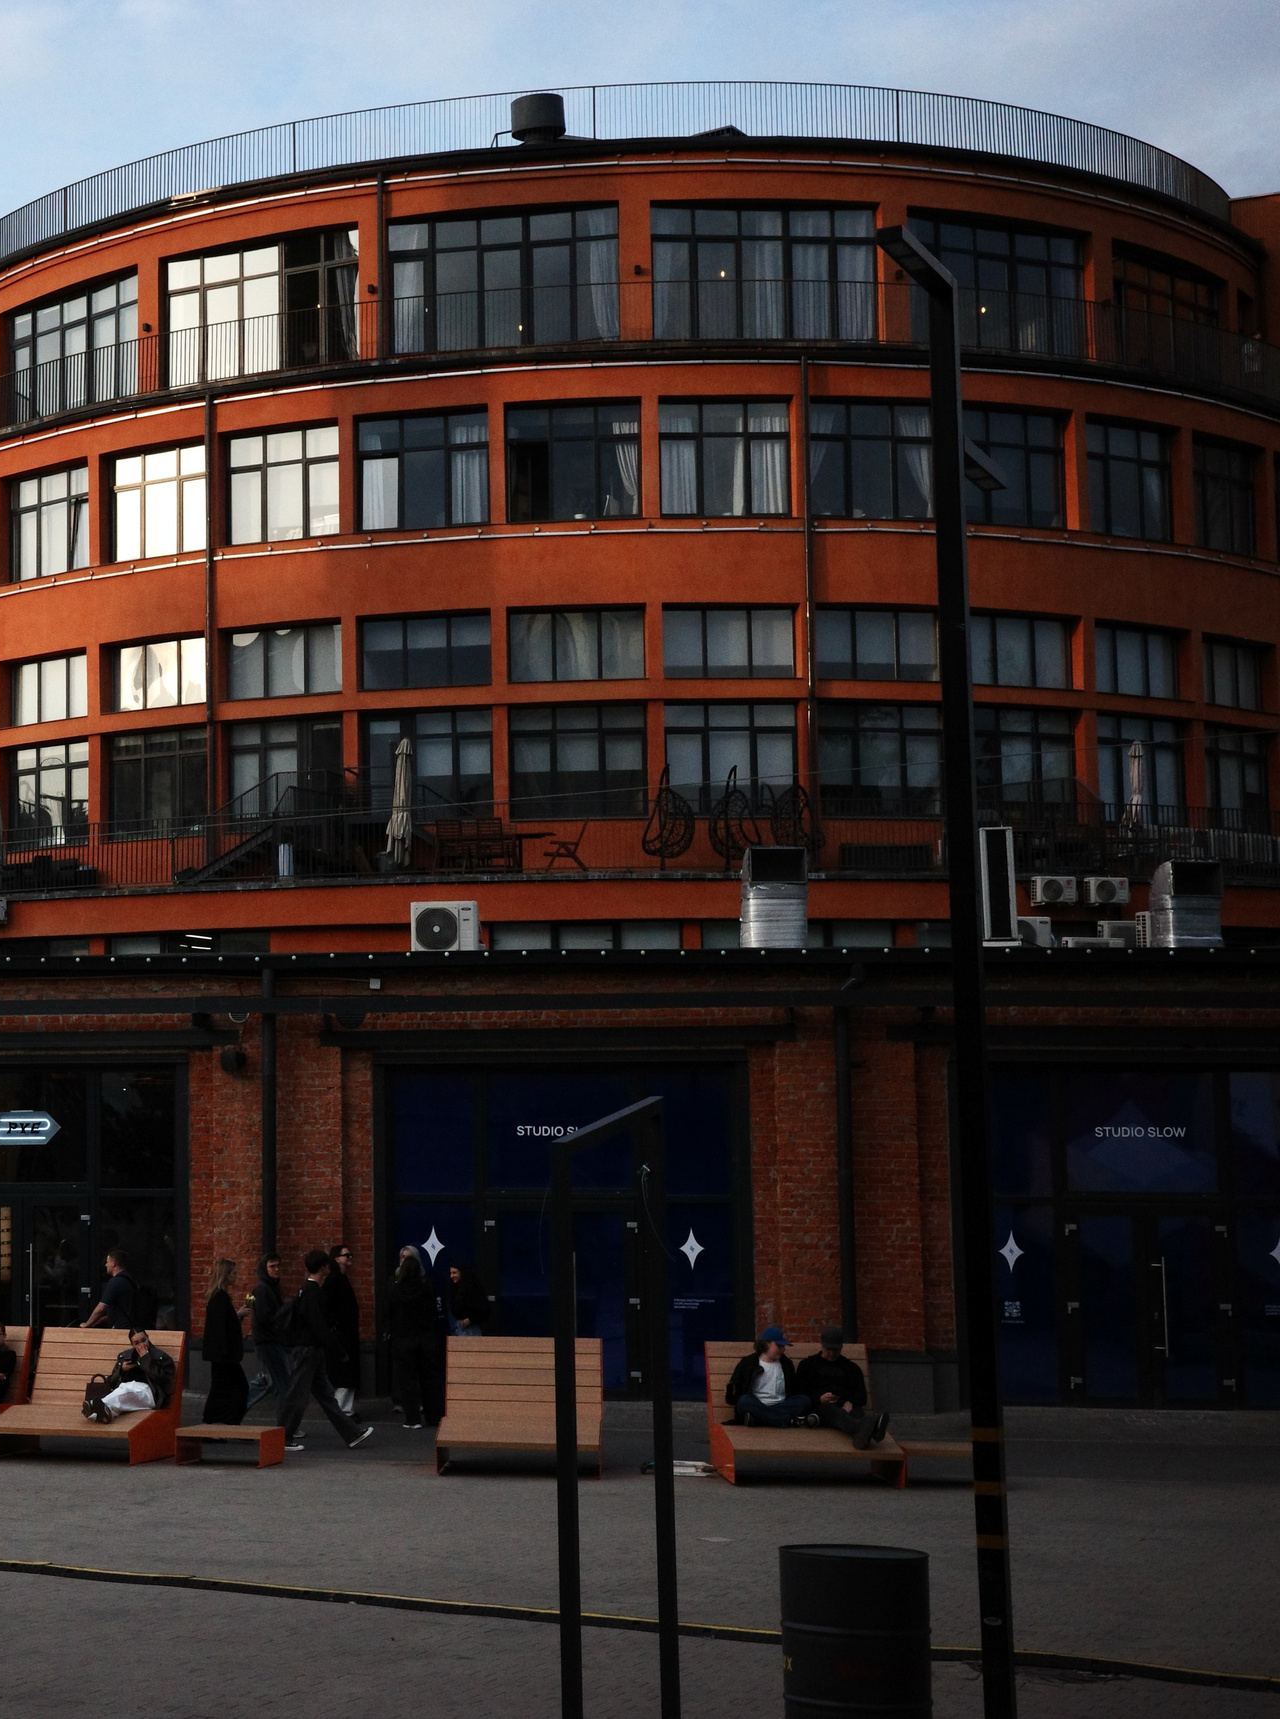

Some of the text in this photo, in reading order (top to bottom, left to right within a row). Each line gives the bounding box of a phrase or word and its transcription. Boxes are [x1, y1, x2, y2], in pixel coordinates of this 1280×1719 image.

[516, 1125, 565, 1137] STUDIO
[1094, 1126, 1187, 1138] STUDIO SLOW
